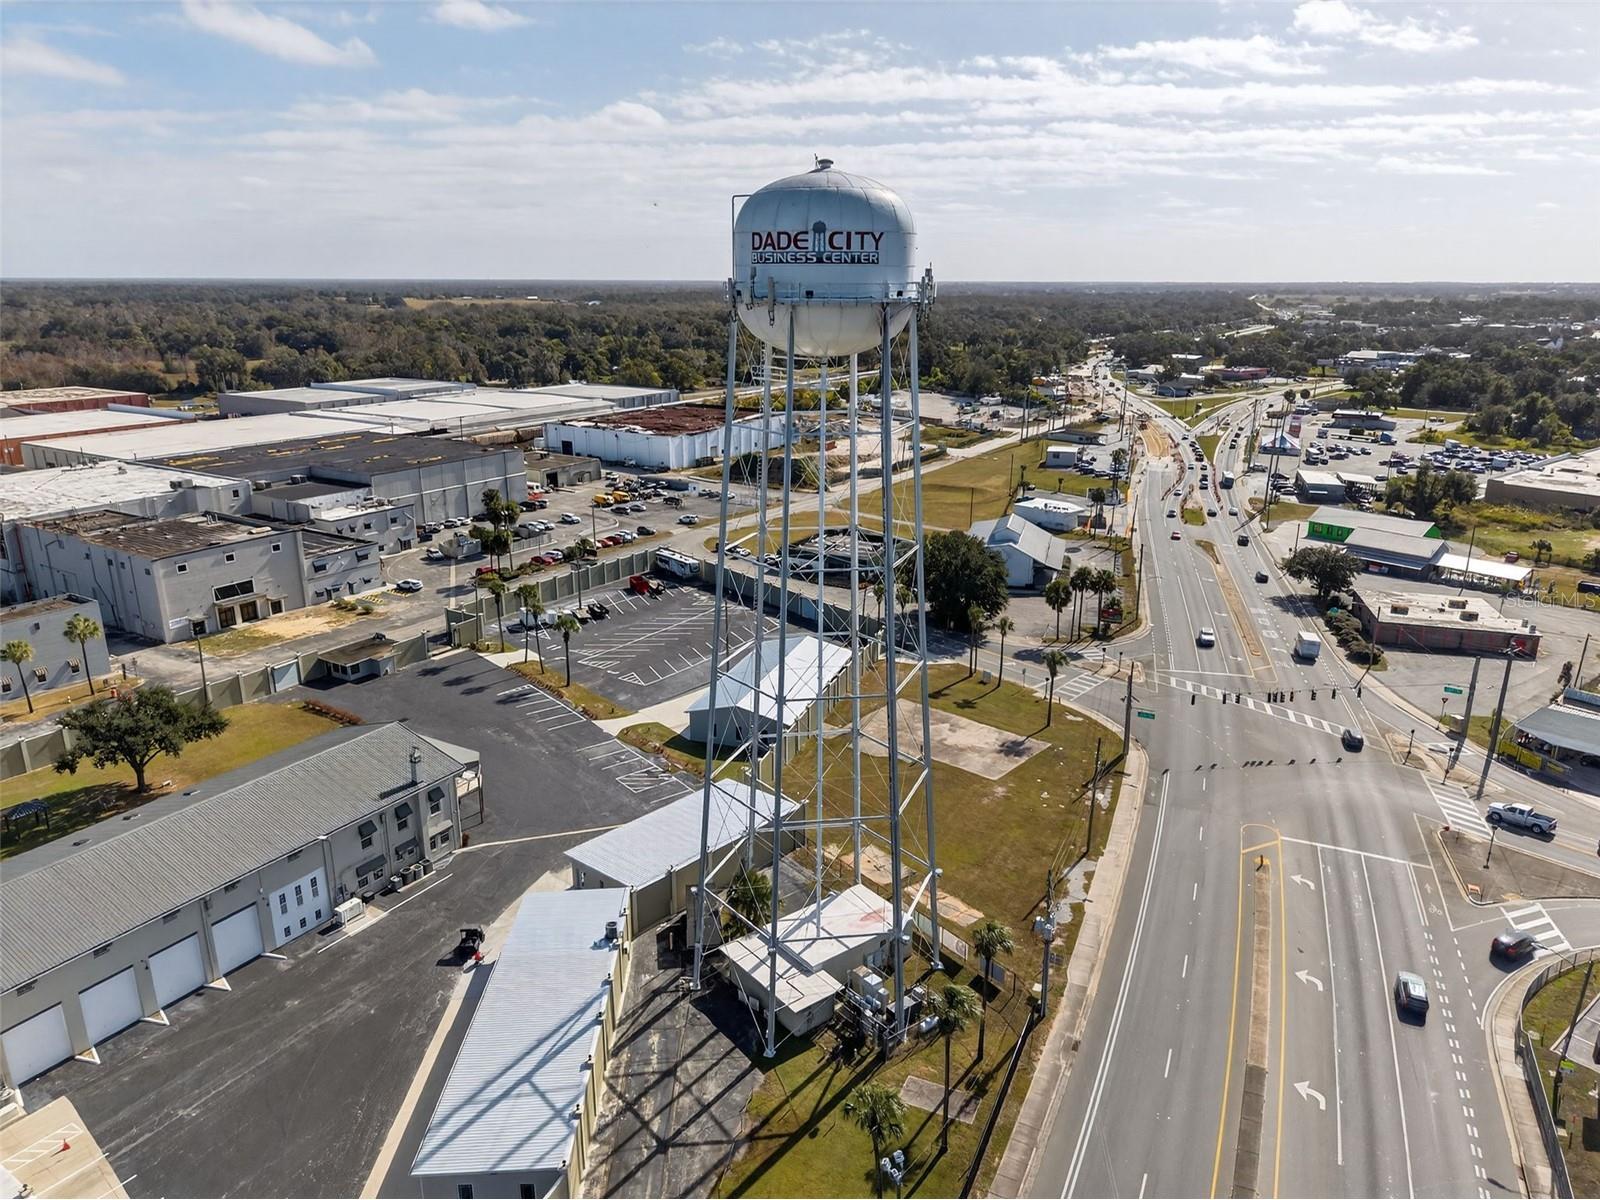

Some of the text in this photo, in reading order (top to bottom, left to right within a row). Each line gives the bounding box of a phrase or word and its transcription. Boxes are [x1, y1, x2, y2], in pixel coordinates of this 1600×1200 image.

[751, 231, 884, 250] DADE CITY
[752, 252, 878, 263] BUSINESS CENTER
